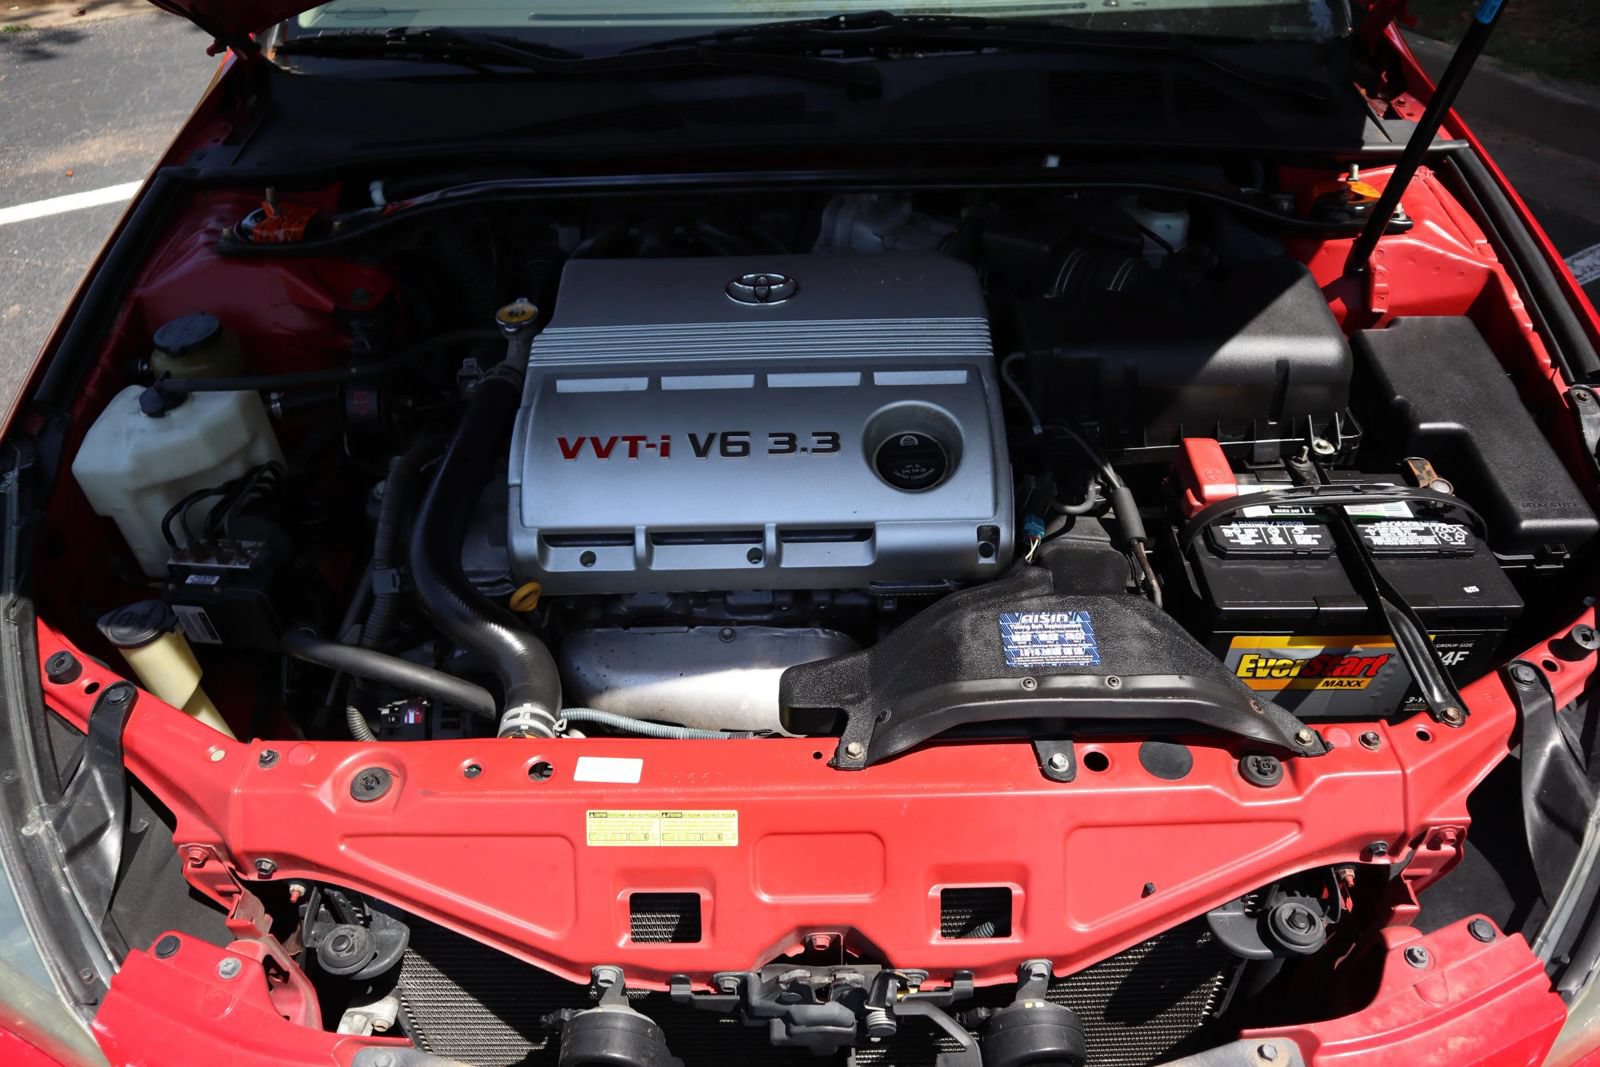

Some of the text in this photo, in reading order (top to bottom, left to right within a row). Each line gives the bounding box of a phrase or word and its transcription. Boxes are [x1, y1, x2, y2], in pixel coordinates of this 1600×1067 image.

[557, 431, 841, 460] VVT-i V6 3.3
[1236, 653, 1392, 678] EverStart
[1322, 679, 1366, 688] MAXX
